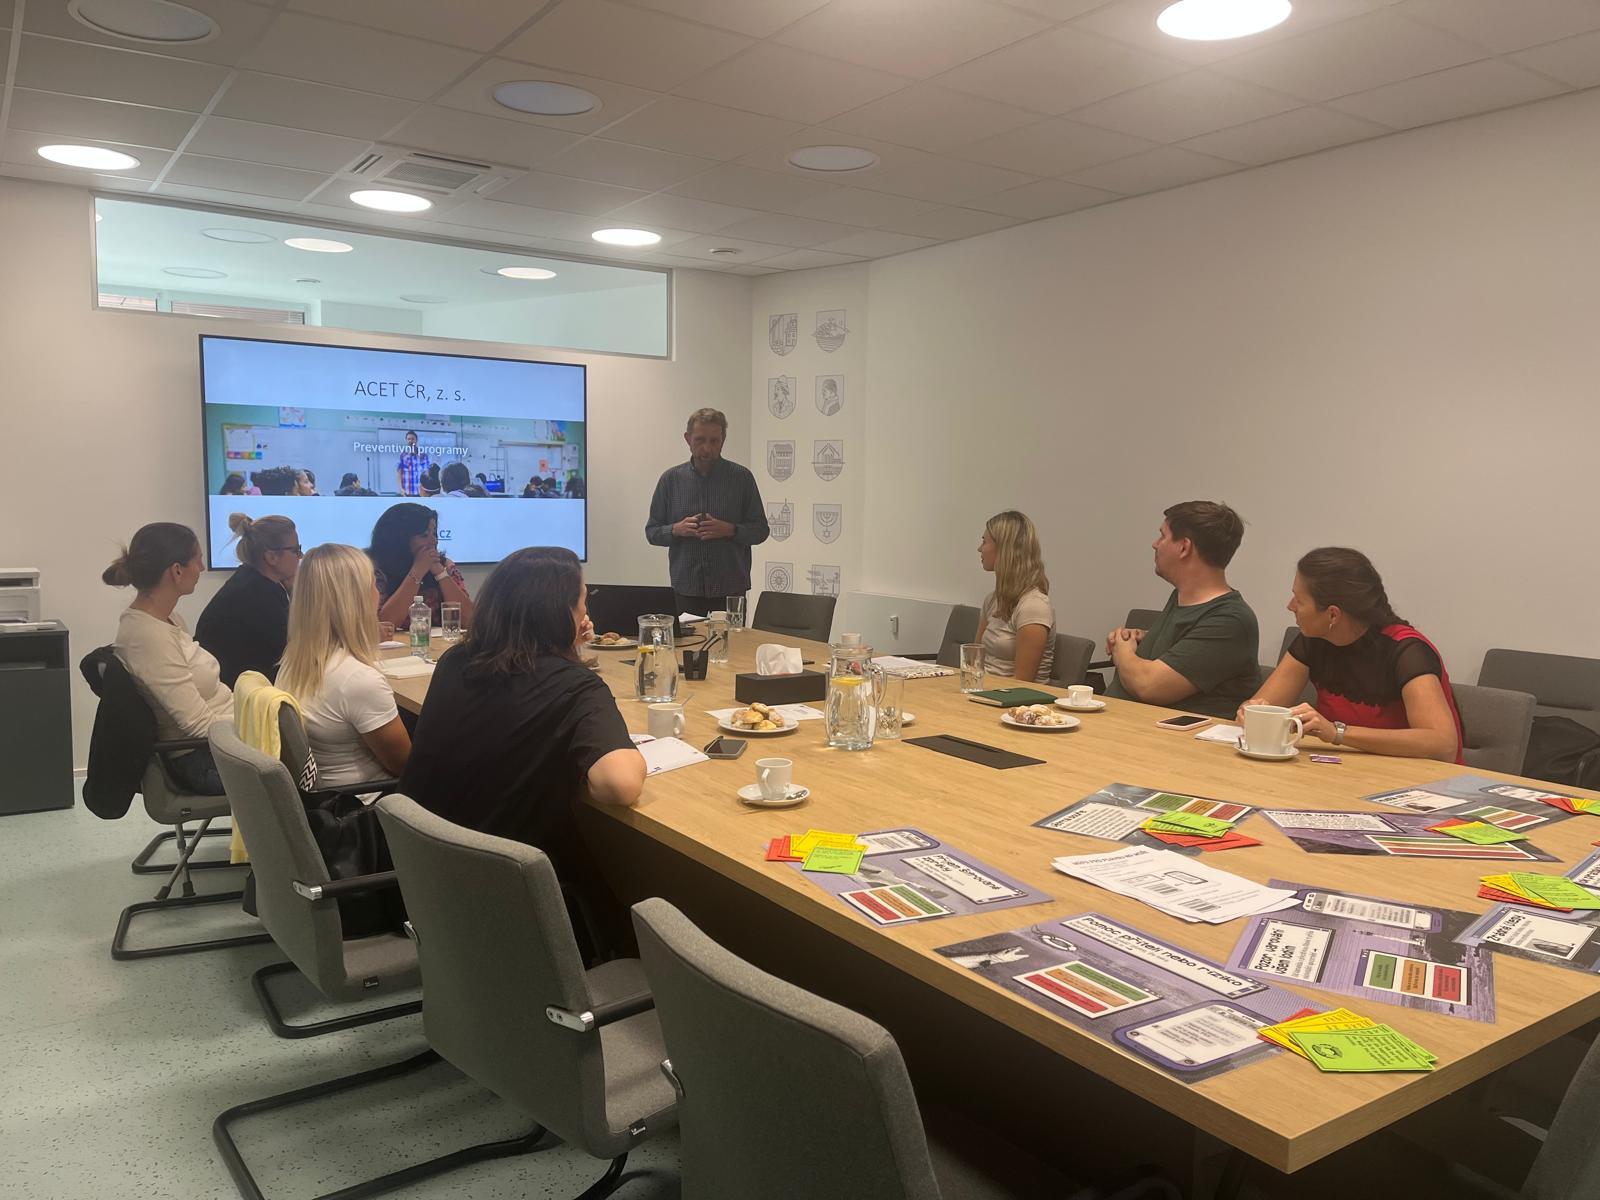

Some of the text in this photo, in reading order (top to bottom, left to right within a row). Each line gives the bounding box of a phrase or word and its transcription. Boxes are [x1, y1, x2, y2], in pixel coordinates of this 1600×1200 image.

[354, 379, 466, 402] ACET ČR, z. s.
[353, 442, 469, 457] Preventivní programy
[1081, 917, 1122, 936] Pomoc
[1160, 950, 1197, 968] nebo
[1197, 966, 1243, 987] riziko
